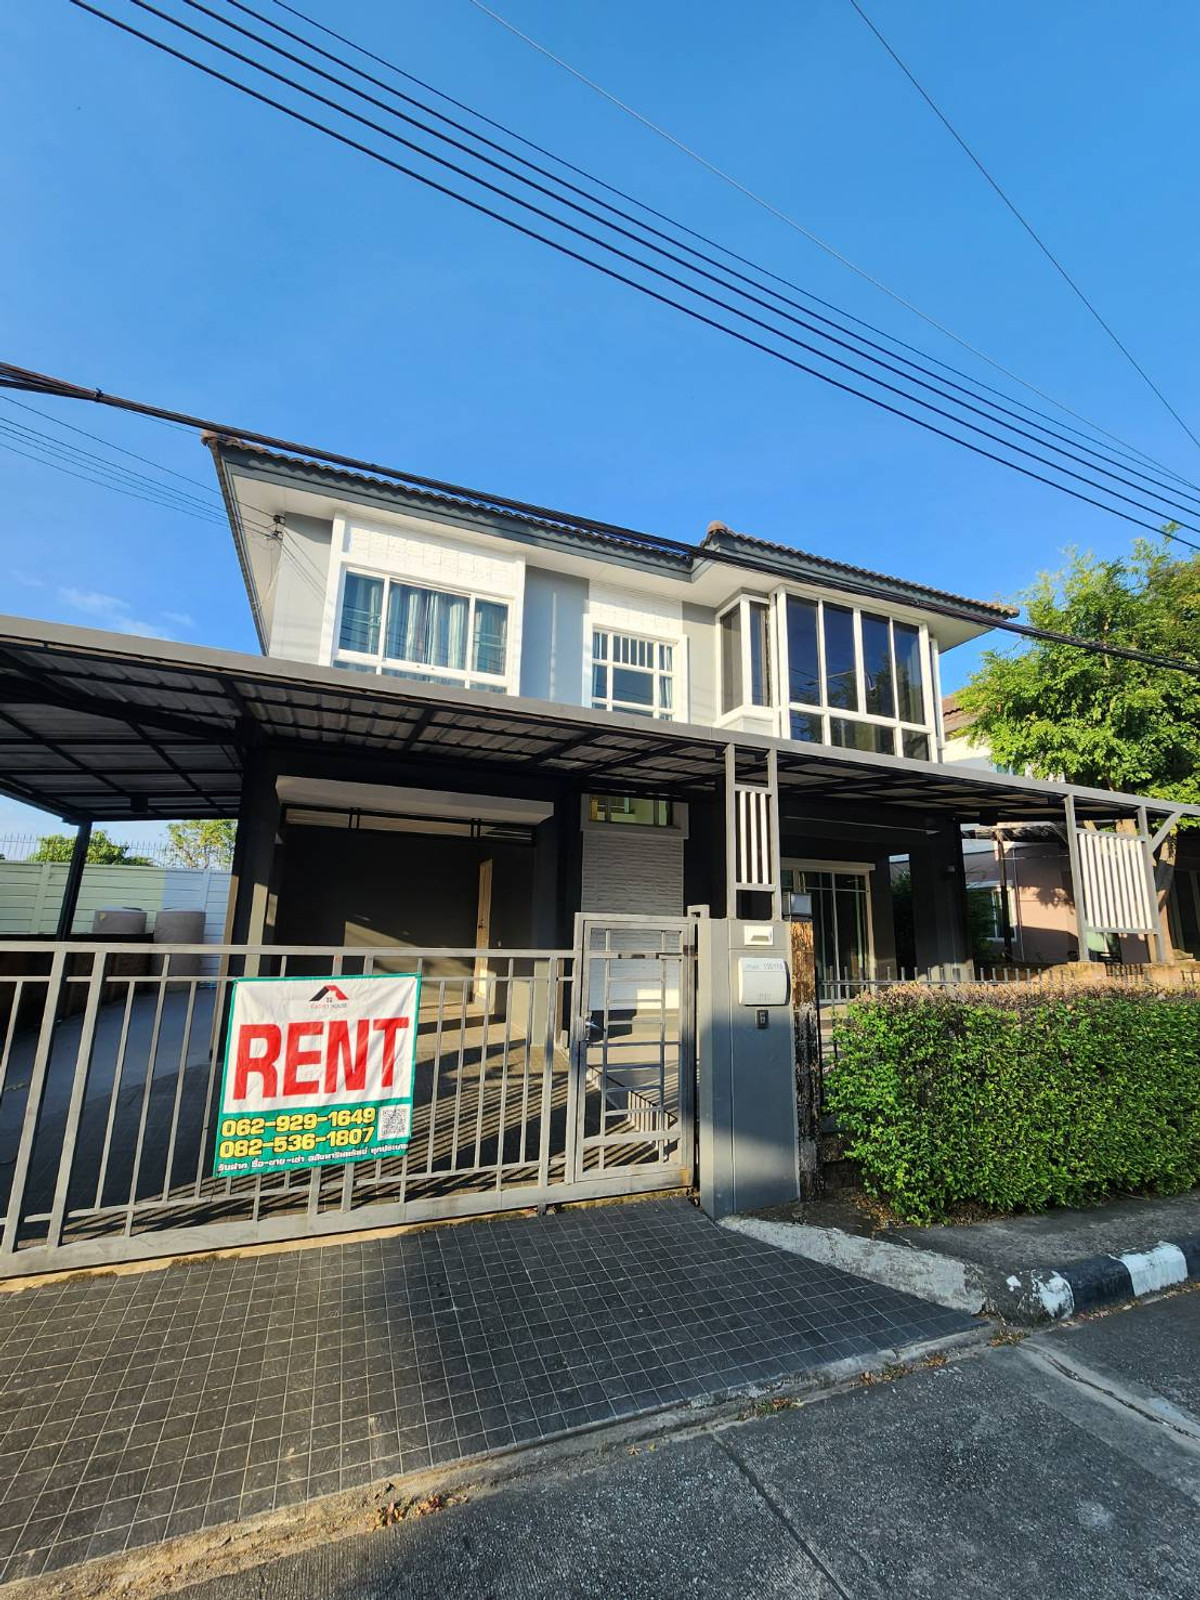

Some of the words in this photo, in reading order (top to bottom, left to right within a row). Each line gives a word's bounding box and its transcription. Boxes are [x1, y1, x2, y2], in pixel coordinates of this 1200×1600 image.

[233, 1017, 409, 1100] RENT
[221, 1107, 376, 1137] 062-929-1649
[219, 1126, 375, 1158] 082-536-1807
